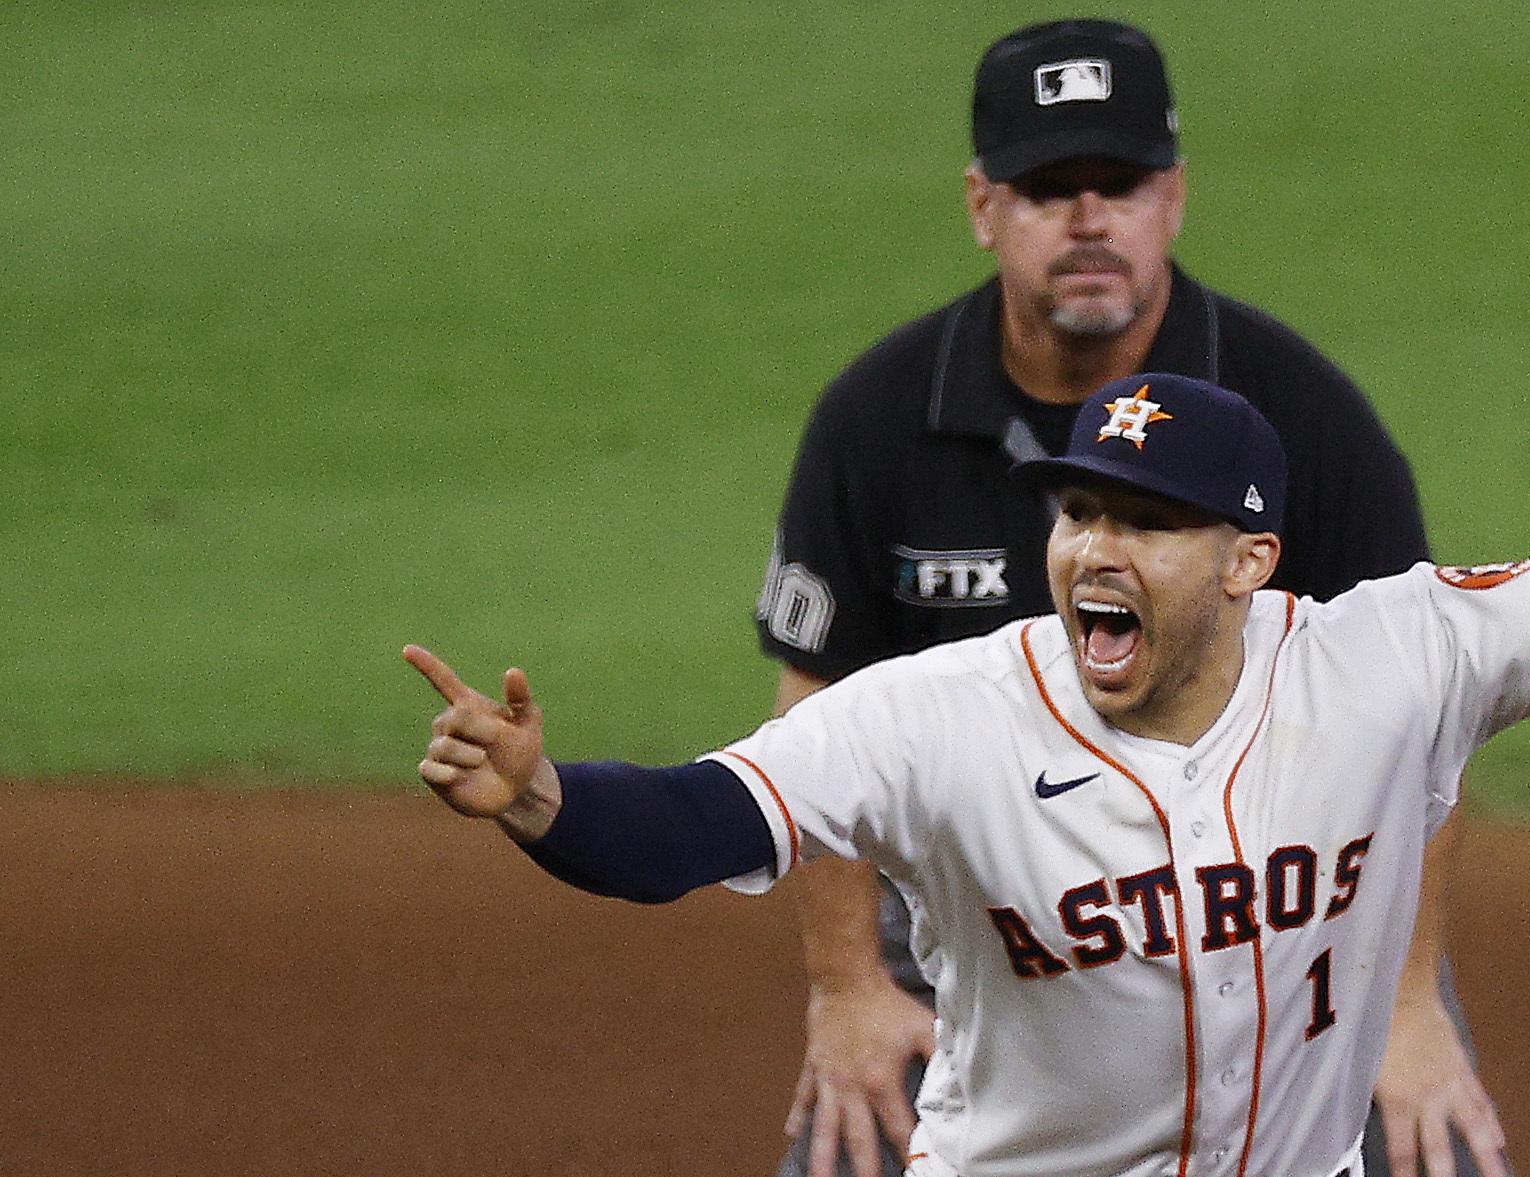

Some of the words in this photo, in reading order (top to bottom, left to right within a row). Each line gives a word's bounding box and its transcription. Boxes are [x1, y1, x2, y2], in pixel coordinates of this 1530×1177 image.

[1099, 398, 1161, 441] H
[916, 558, 1009, 599] FTX
[987, 832, 1374, 978] ASTROS
[1305, 948, 1336, 1041] 1
